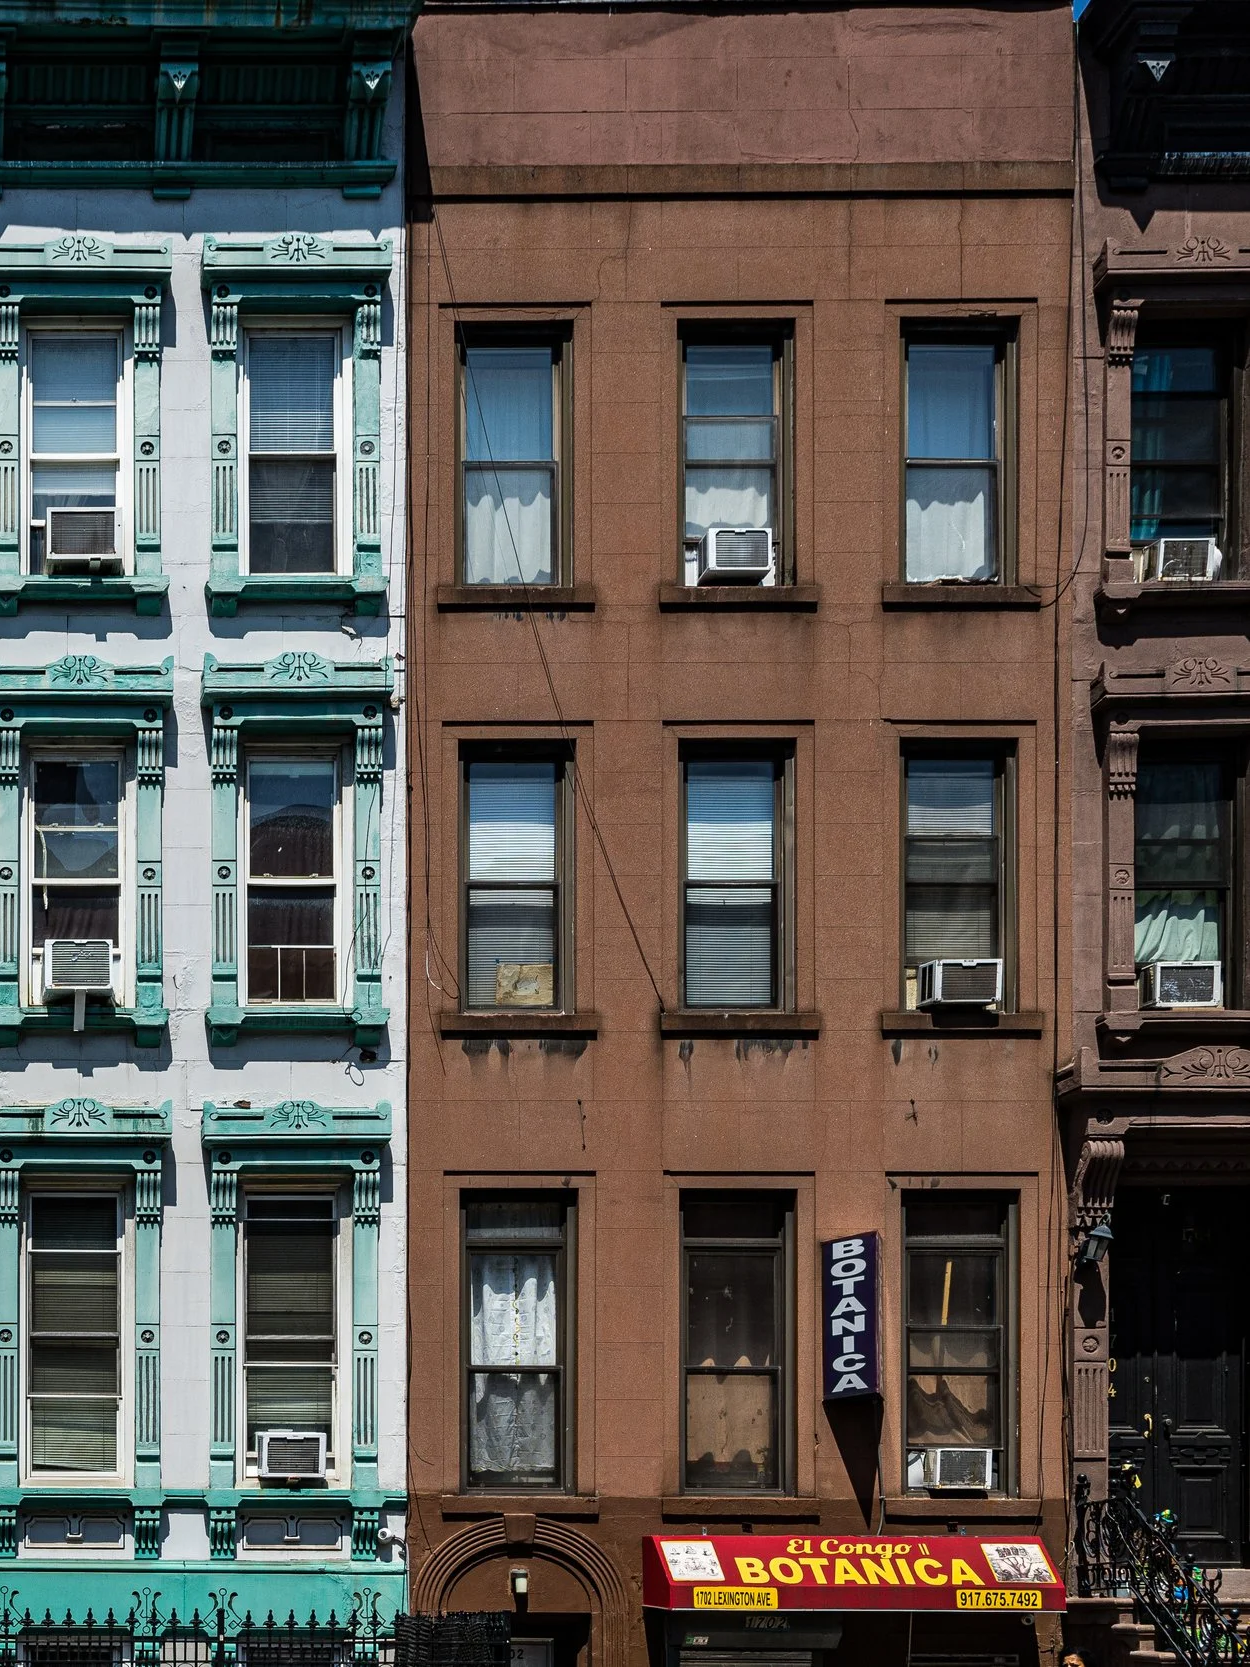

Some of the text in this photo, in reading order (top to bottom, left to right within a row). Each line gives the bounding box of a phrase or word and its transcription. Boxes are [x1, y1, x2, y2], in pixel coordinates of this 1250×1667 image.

[830, 1238, 869, 1393] BOTANICA
[786, 1538, 812, 1555] El
[819, 1538, 913, 1559] Congo
[733, 1556, 986, 1586] BOTANICA
[696, 1591, 773, 1607] 1702 LEXINGTON AVE.
[960, 1591, 1038, 1607] 917.675.7492
[747, 1615, 788, 1629] 1702
